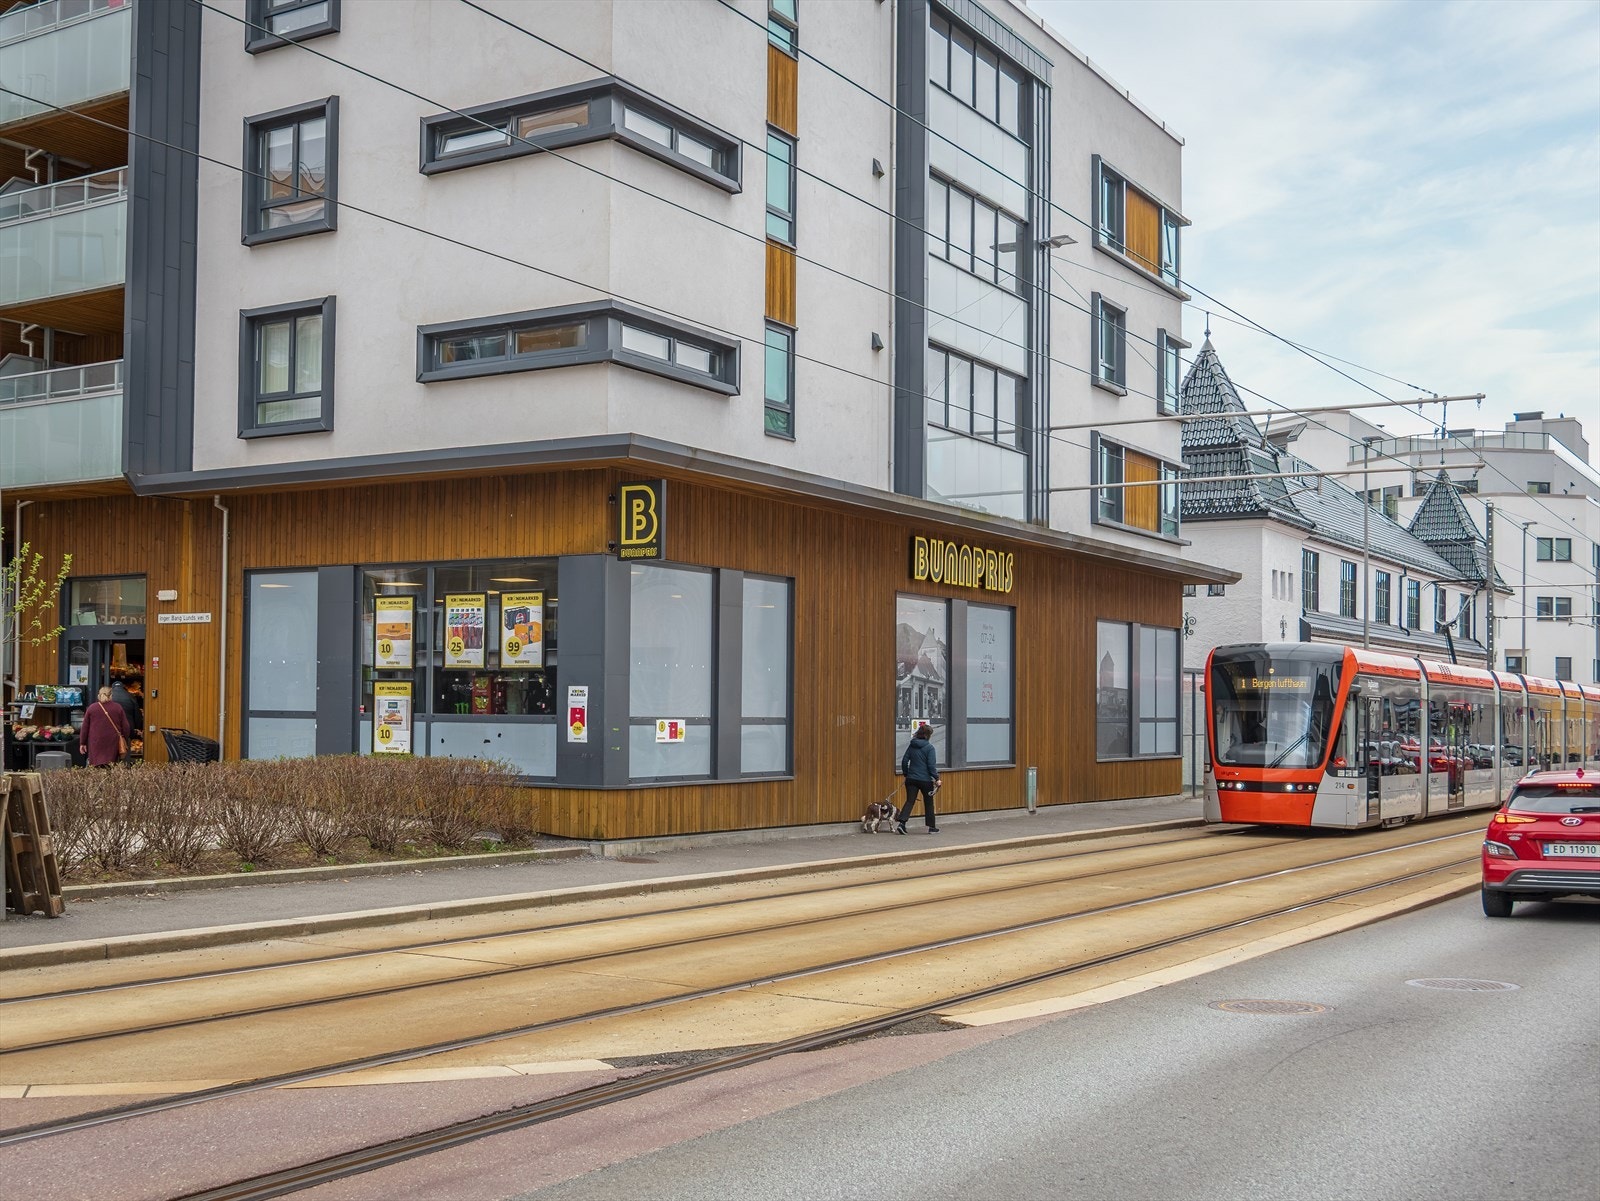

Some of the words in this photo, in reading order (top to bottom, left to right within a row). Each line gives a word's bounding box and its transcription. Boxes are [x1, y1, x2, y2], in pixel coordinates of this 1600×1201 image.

[914, 535, 1014, 593] BUNNPRIS
[381, 643, 391, 653] 10
[451, 642, 462, 652] 25
[508, 641, 520, 652] 99
[1241, 678, 1246, 689] 1
[1252, 678, 1276, 689] Bergen
[1277, 678, 1307, 688] lufthavn
[380, 729, 391, 739] 10
[1553, 845, 1566, 854] ED
[1570, 845, 1597, 854] 11910
